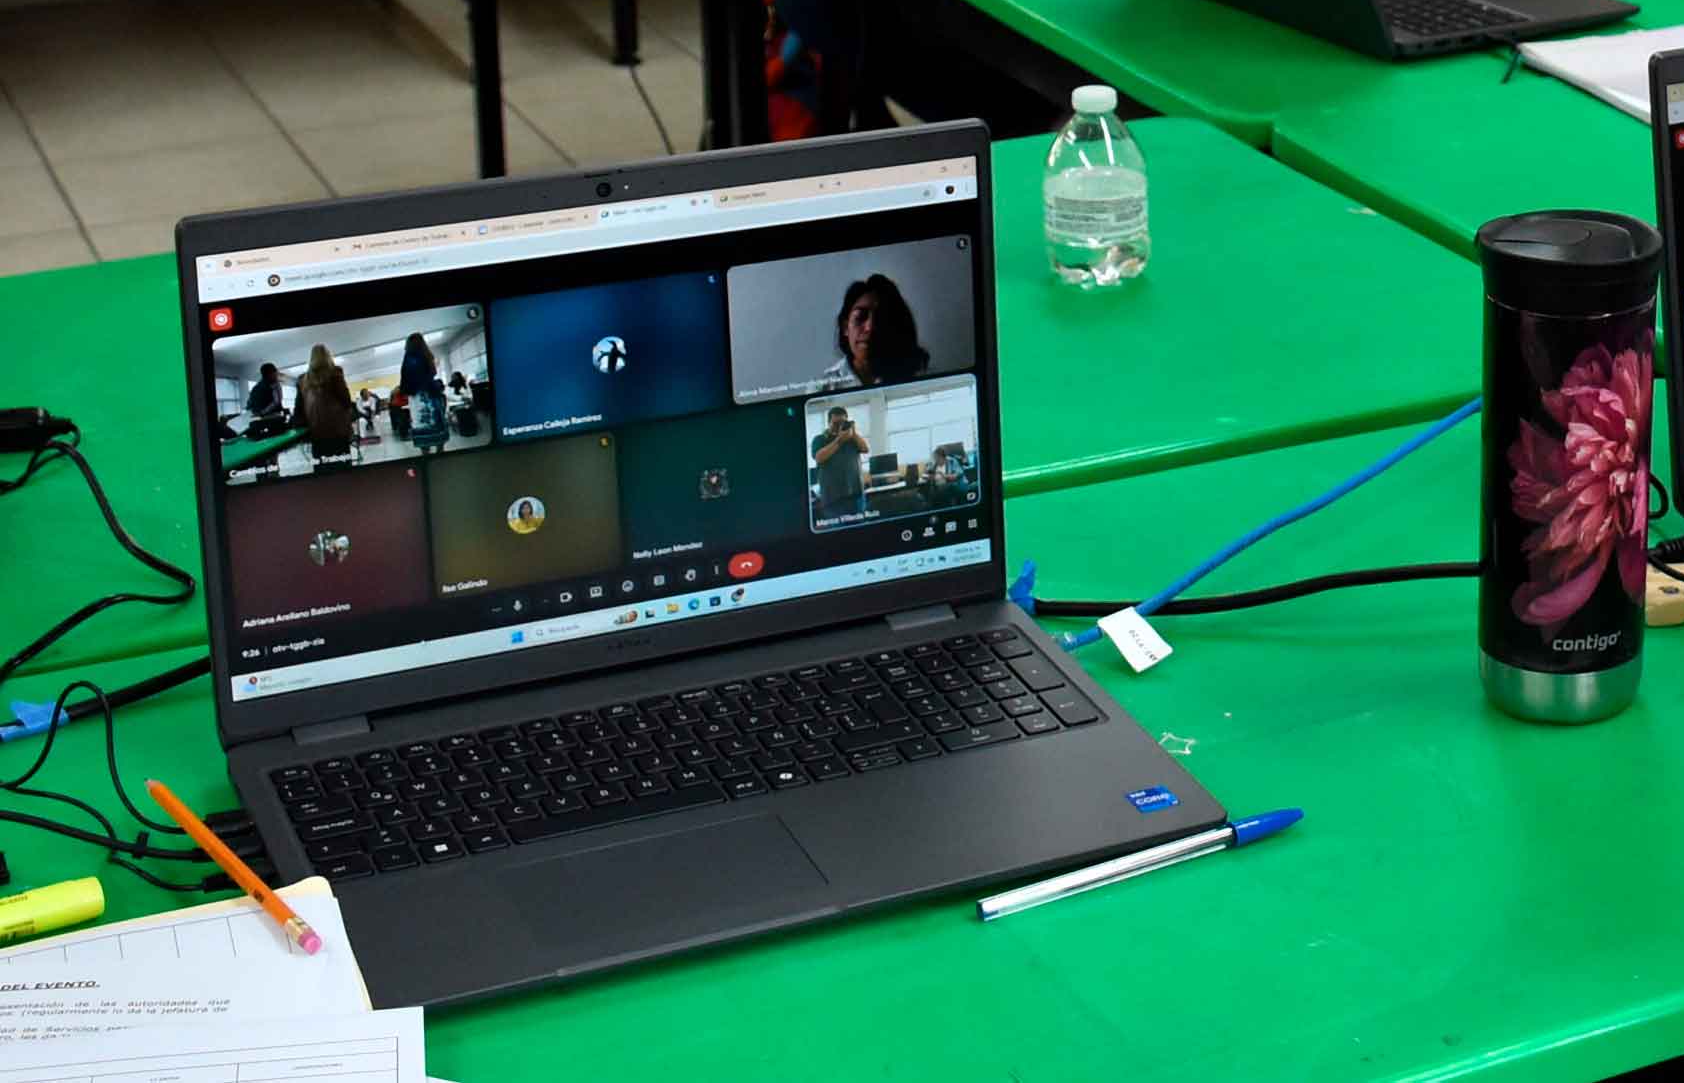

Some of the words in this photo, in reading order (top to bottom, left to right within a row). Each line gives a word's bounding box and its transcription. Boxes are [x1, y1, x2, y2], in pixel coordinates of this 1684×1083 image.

[242, 616, 275, 629] Adriana
[1552, 633, 1618, 651] contigo
[0, 983, 29, 992] DEL
[33, 980, 100, 991] EVENTO.
